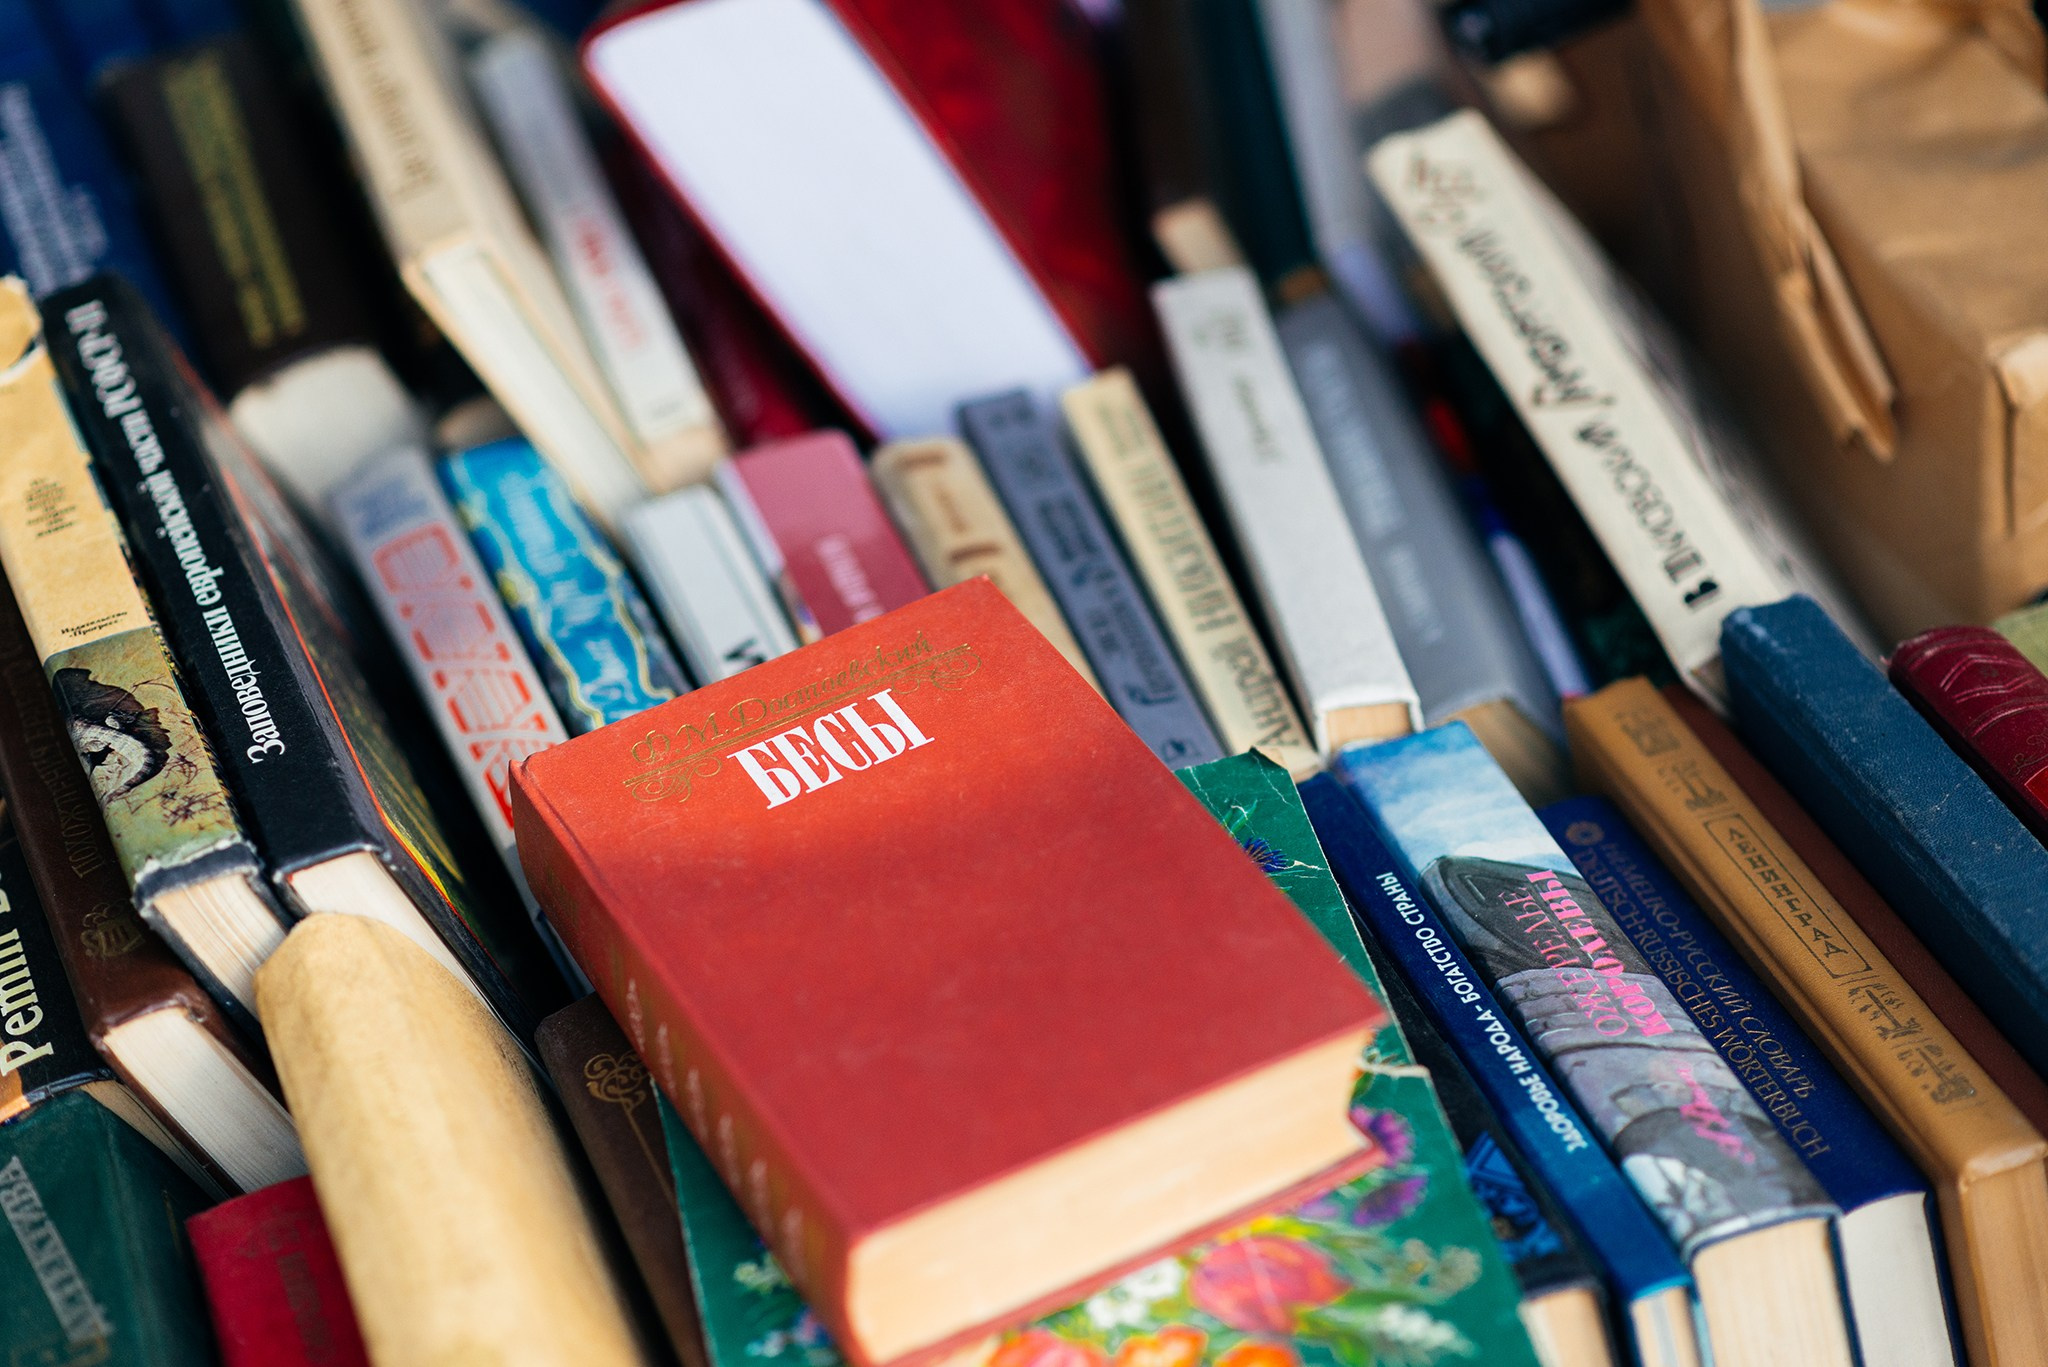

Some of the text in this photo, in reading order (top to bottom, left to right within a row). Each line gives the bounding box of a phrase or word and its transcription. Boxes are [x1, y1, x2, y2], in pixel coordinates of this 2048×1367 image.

[134, 466, 224, 607] европейской
[202, 604, 285, 764] Заповедники
[1208, 633, 1301, 747] Андрей
[726, 688, 935, 809] БЕСЫ
[1375, 870, 1425, 927] СТРАНЫ
[1524, 867, 1673, 1038] КОРОЛЕВЫ
[1414, 923, 1481, 1004] БОГАТСТВО
[1497, 886, 1630, 1035] ОЖЕРЕЛЬЕ
[1475, 1007, 1531, 1074] НАРОДА
[1711, 1026, 1831, 1159] WÖRTERBUCH
[1738, 1015, 1818, 1099] СЛОВАРЬ
[1517, 1071, 1587, 1154] ЗДОРОВЬЕ
